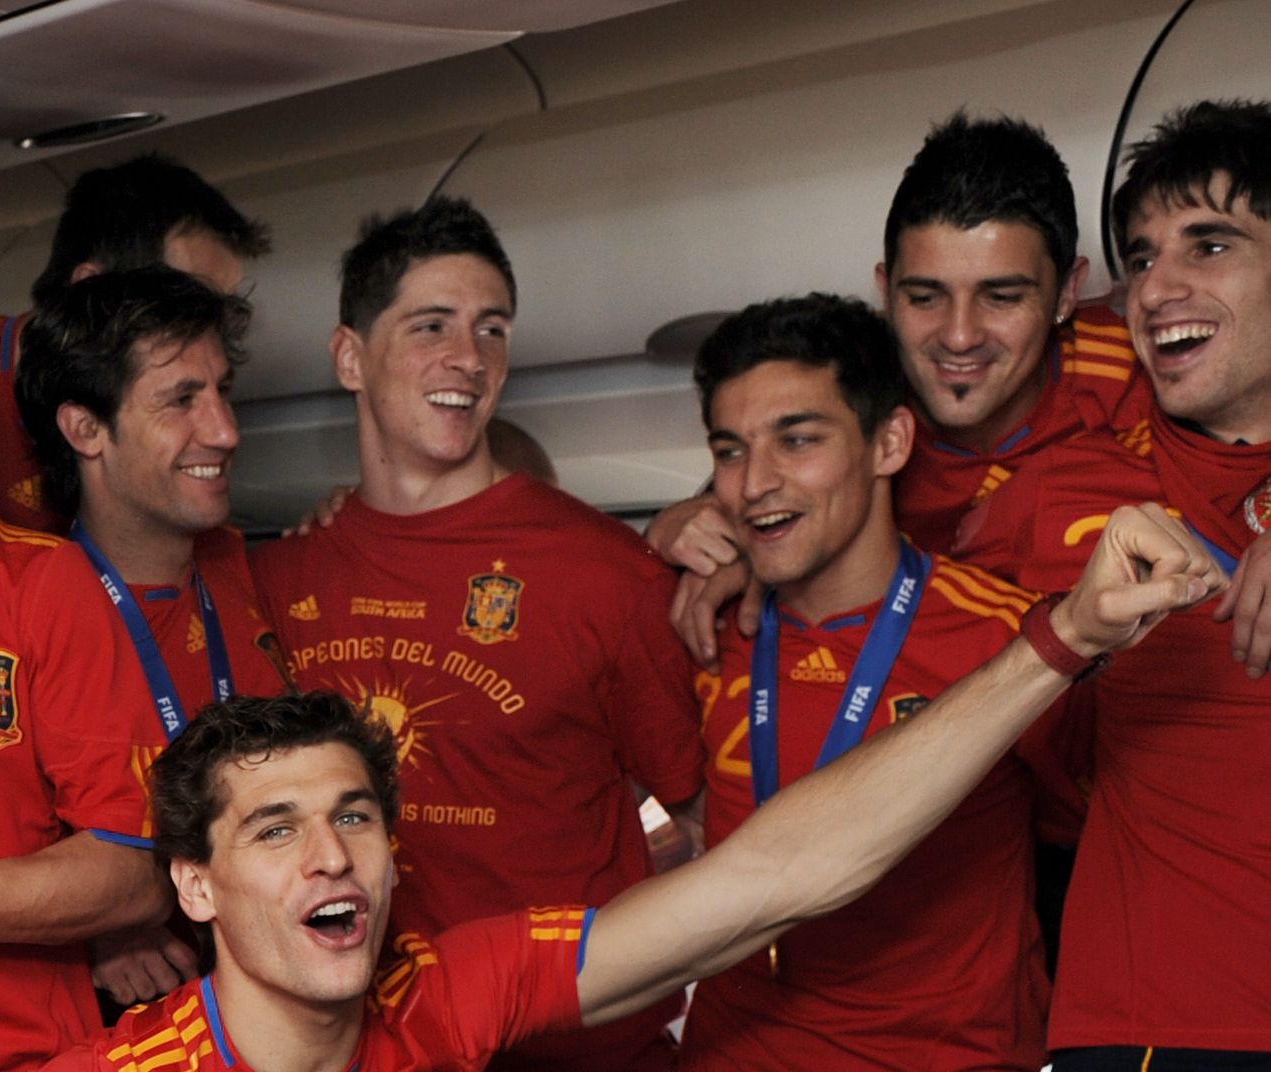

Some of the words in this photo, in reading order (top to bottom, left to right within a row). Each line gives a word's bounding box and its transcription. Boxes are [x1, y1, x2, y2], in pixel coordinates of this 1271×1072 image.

[892, 577, 916, 614] FIFA
[391, 638, 436, 667] DEL
[441, 651, 526, 715] MUNDO
[790, 667, 846, 683] adidas
[158, 695, 181, 732] FIFA
[844, 685, 872, 723] FIFA
[401, 803, 418, 821] IS
[423, 804, 497, 826] NOTHING
